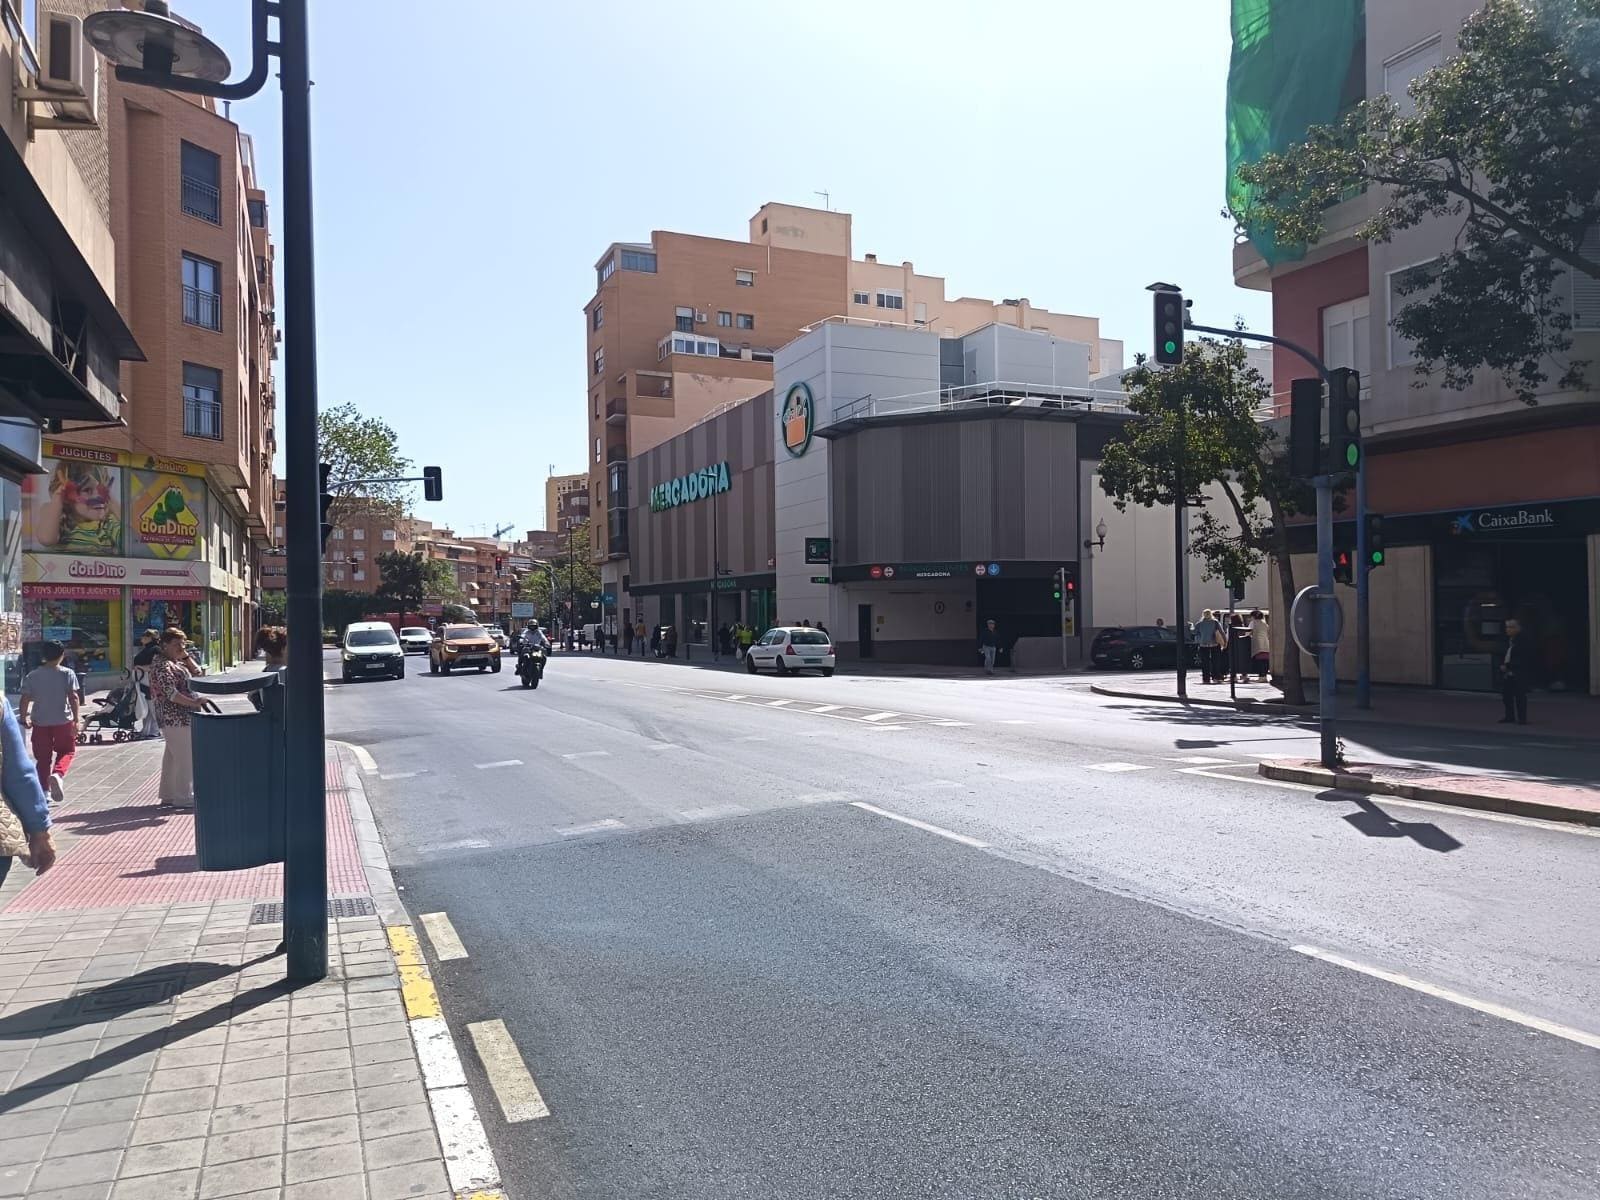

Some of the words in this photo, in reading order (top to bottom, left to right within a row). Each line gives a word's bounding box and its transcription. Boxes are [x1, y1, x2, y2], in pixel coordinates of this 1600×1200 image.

[59, 447, 112, 462] JUGUETES
[650, 461, 729, 511] MERCADONA
[1478, 508, 1554, 527] CaixaBank
[140, 518, 197, 536] donDino
[69, 560, 127, 579] donDino
[33, 586, 51, 594] TOYS
